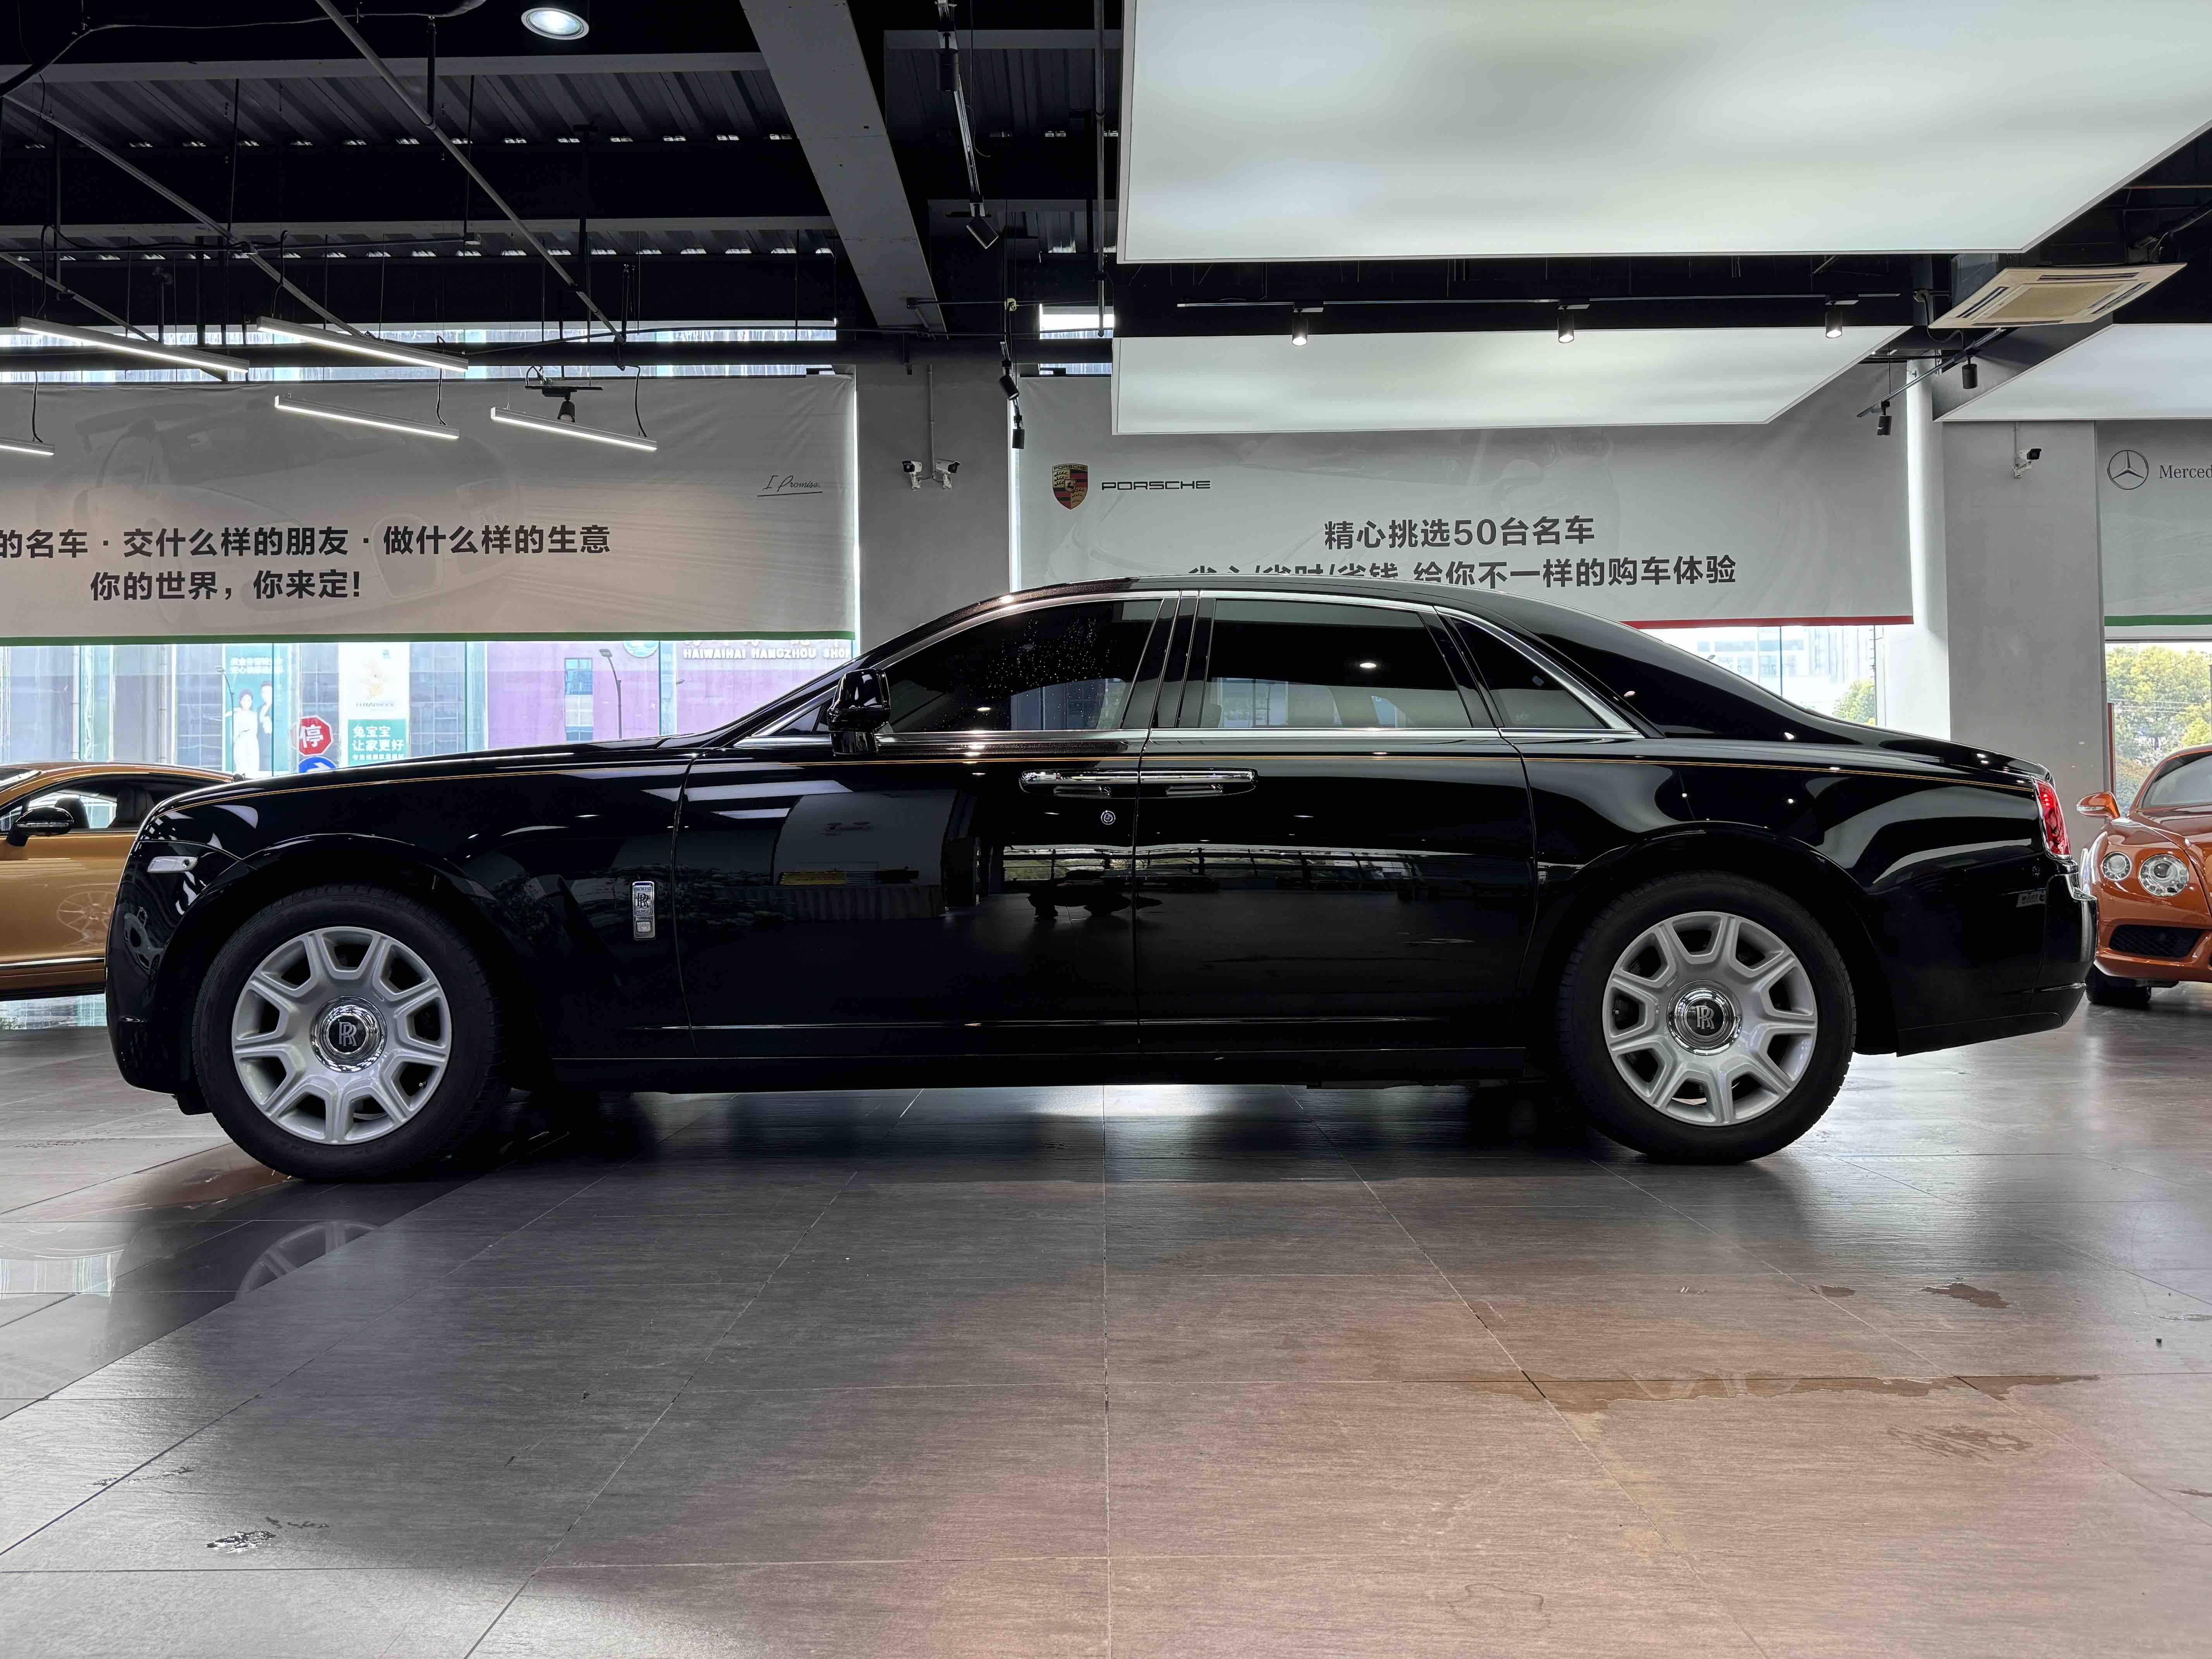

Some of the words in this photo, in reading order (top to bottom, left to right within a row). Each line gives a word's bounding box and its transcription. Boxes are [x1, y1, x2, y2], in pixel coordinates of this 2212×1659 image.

[1101, 480, 1211, 491] PORSCHE
[1324, 515, 1595, 550] 精心挑选50台名车
[684, 648, 747, 659] HAIWAIHAI
[751, 647, 817, 659] HANGZHOU
[299, 724, 324, 748] 停
[352, 739, 404, 752] 让家更好
